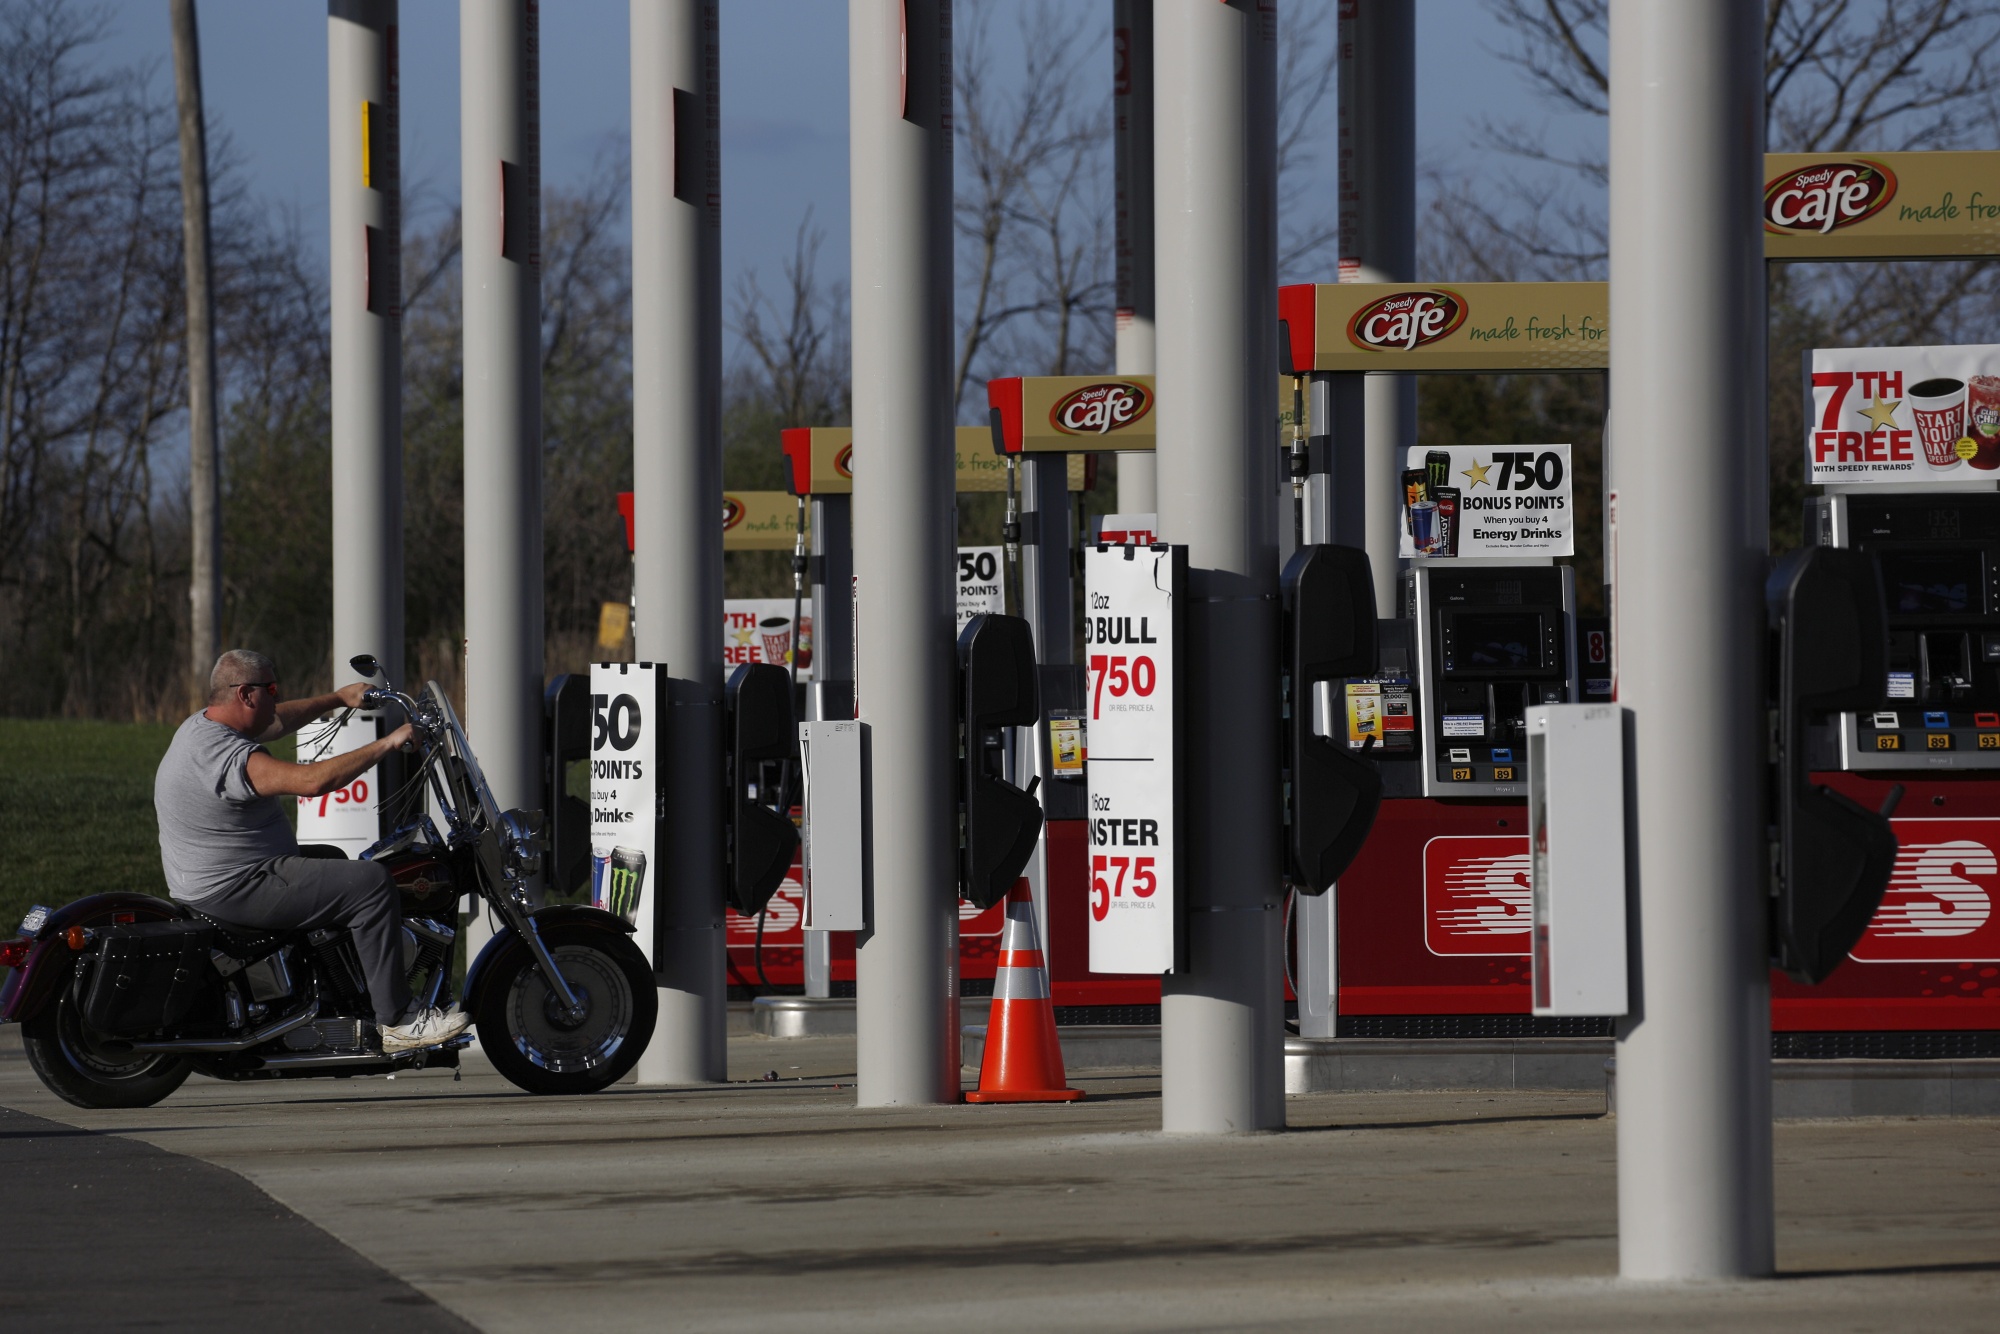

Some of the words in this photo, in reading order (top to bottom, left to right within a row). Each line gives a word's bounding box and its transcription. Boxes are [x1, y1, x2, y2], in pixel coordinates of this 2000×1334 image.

[1795, 169, 1834, 188] Speedy
[1899, 191, 1960, 222] made
[1384, 297, 1416, 312] Speedy
[1470, 316, 1520, 341] made
[1525, 314, 1575, 341] fresh
[1578, 316, 1606, 341] for
[1081, 388, 1108, 401] Speedy
[1916, 406, 1962, 428] START
[1920, 422, 1961, 442] YOUR
[1815, 430, 1914, 463] FREE
[1925, 441, 1948, 456] DAY
[1928, 451, 1958, 464] SPEEDWA
[1491, 452, 1563, 491] 750
[1814, 465, 1835, 473] WITH
[1838, 464, 1869, 472] SPEEDY
[1463, 496, 1512, 510] BONUS
[1515, 496, 1565, 510] POINTS
[1483, 516, 1507, 524] When
[1508, 517, 1524, 526] you
[1525, 516, 1541, 526] buy
[1542, 516, 1549, 524] 4
[1473, 529, 1518, 541] Energy
[1521, 528, 1562, 539] Drinks
[957, 552, 997, 582] 50
[961, 585, 998, 596] POINTS
[1091, 591, 1110, 609] 12oz
[724, 612, 756, 629] TH
[1097, 617, 1157, 644] BULL
[724, 646, 761, 664] REE
[1590, 633, 1606, 662] 8
[1109, 704, 1116, 712] OR
[590, 693, 641, 751] 50
[1880, 738, 1895, 748] 87
[1931, 738, 1946, 748] 89
[1981, 737, 1997, 746] 93
[594, 760, 642, 780] POINTS
[1455, 771, 1468, 779] 87
[1497, 771, 1509, 779] 89
[597, 790, 609, 802] buy
[610, 790, 617, 800] 4
[595, 807, 634, 823] Drinks
[1130, 901, 1146, 909] PRICE
